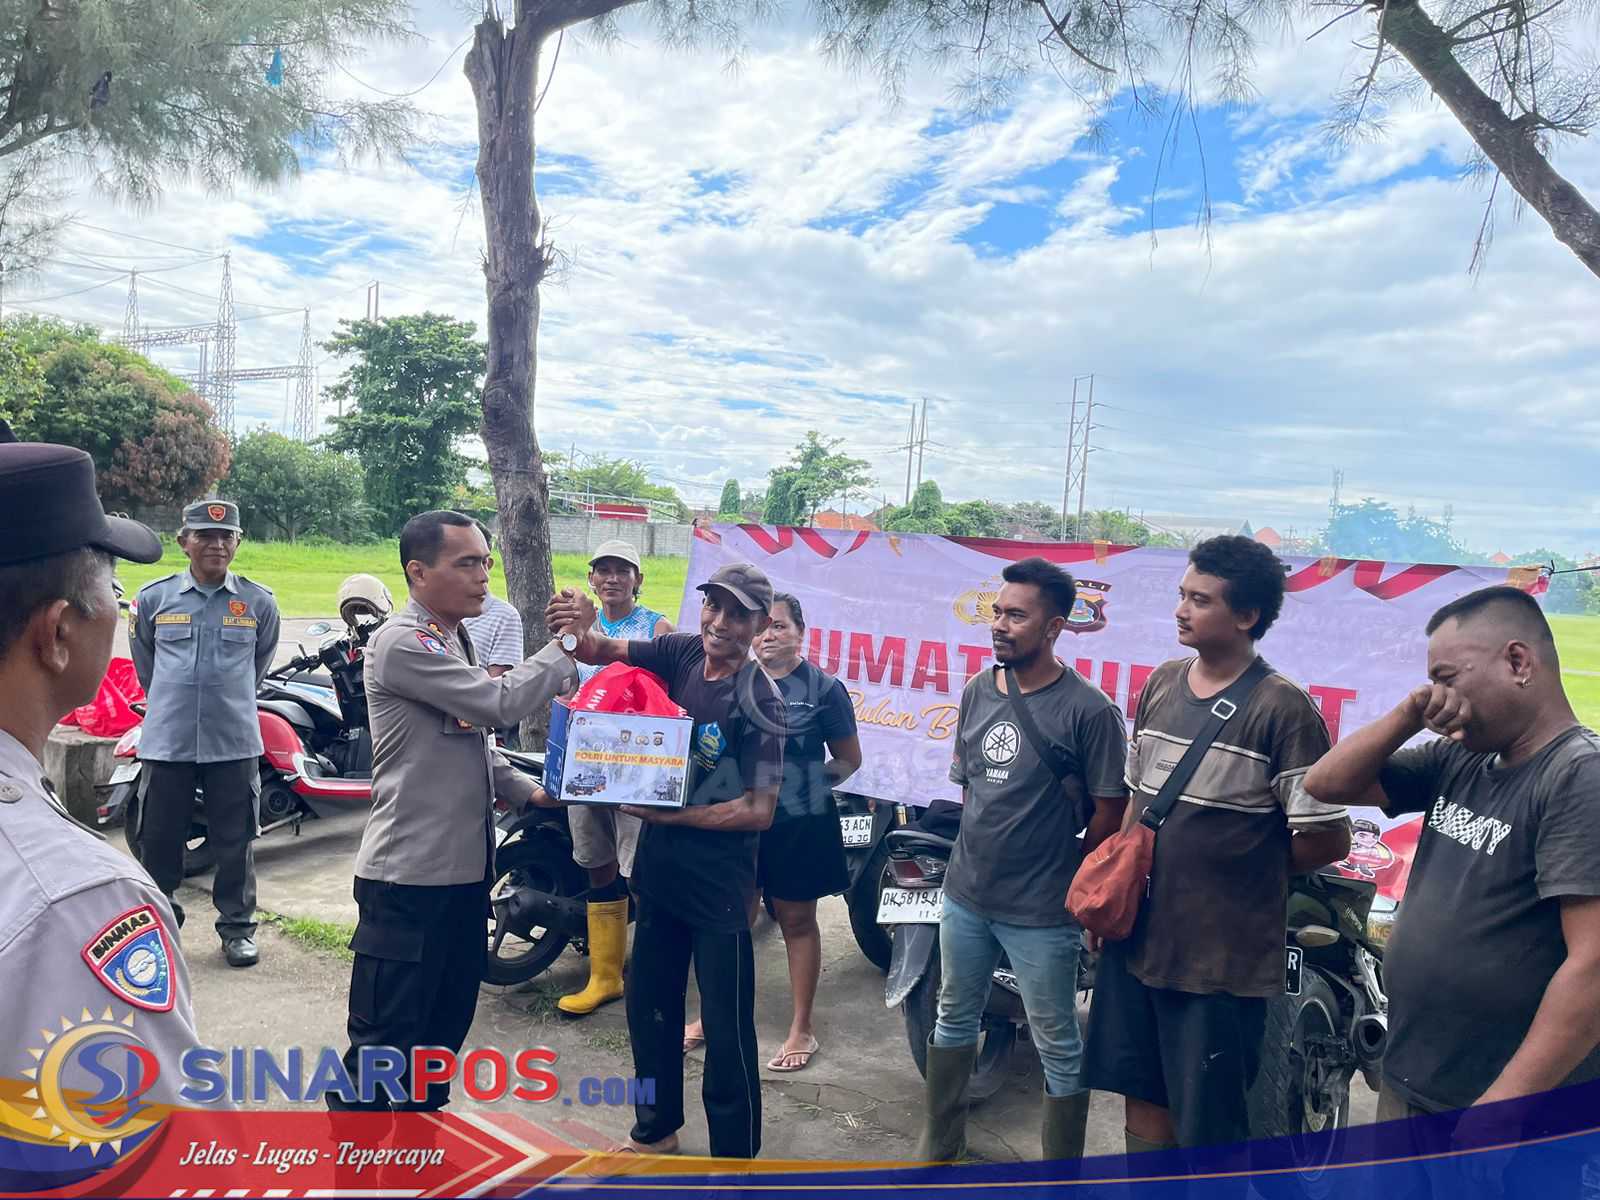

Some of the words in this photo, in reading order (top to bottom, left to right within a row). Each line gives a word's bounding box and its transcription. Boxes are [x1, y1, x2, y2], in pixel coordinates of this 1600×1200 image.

[1074, 581, 1106, 590] ALI
[807, 627, 993, 695] UMAT
[575, 751, 603, 762] POLRI
[605, 753, 638, 765] UNTUK
[92, 913, 151, 959] BINMAS
